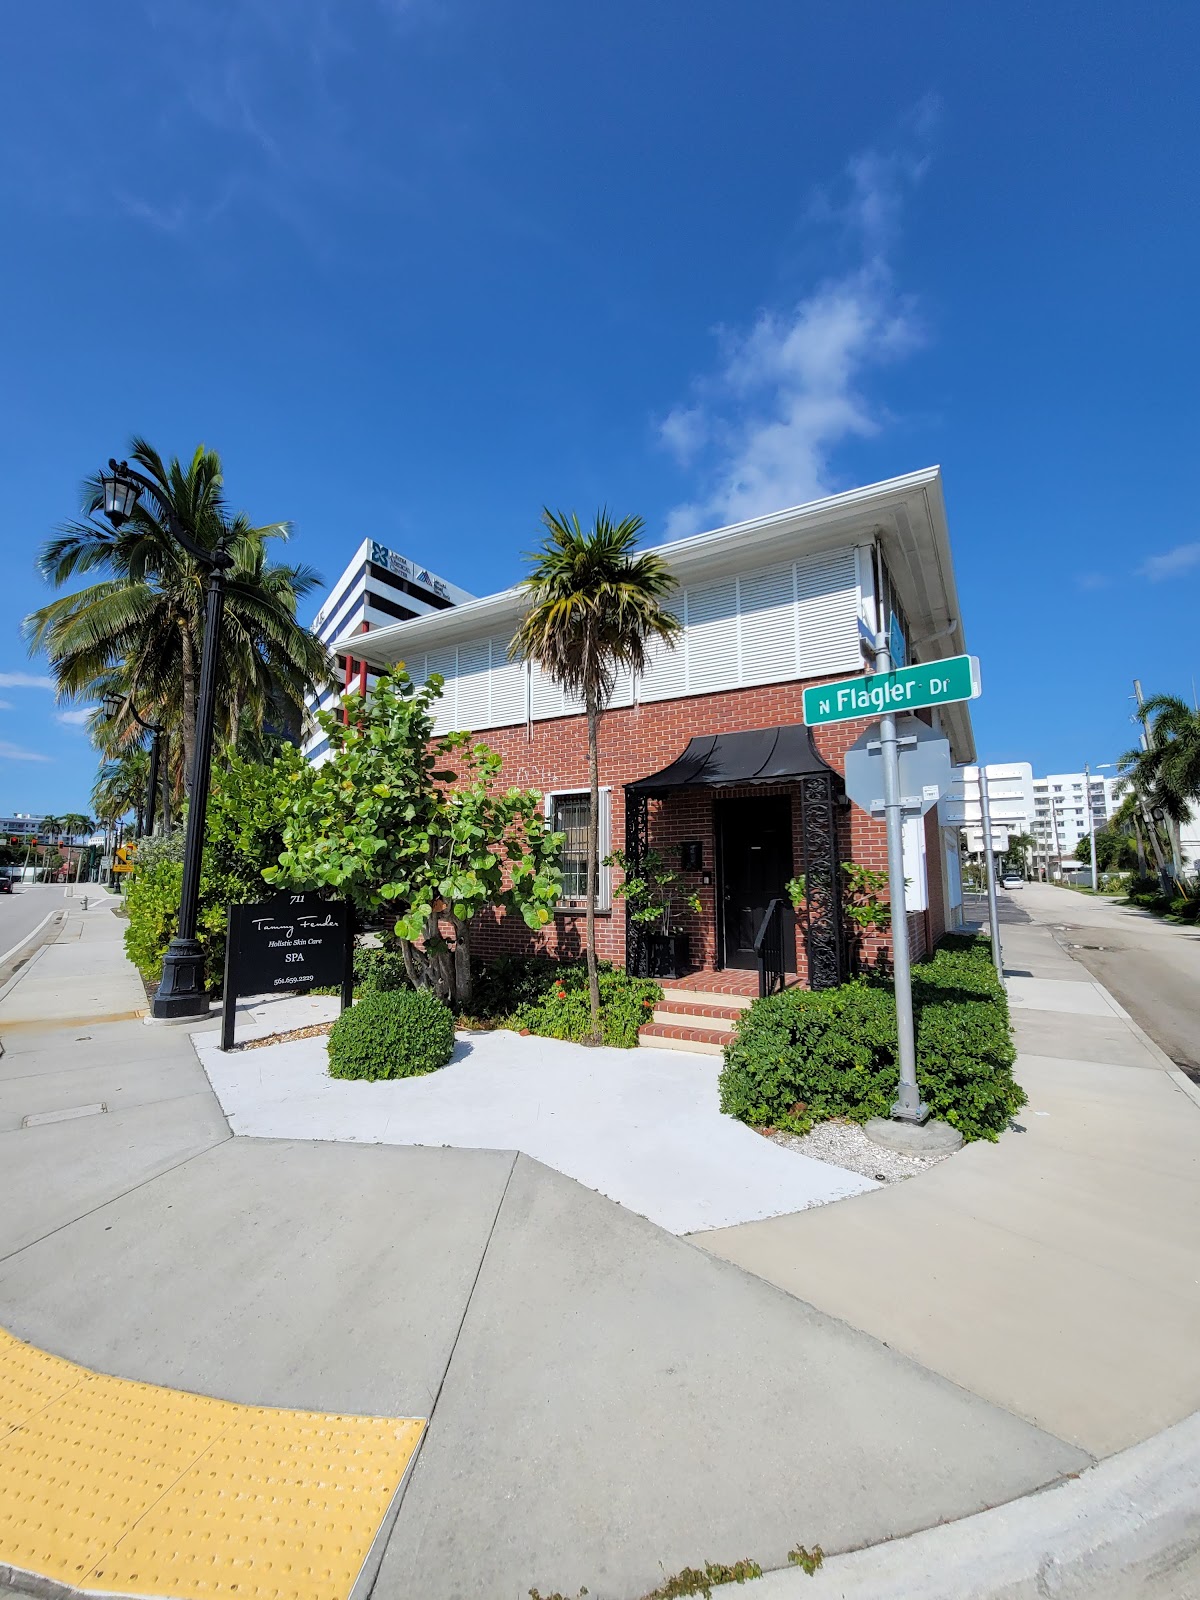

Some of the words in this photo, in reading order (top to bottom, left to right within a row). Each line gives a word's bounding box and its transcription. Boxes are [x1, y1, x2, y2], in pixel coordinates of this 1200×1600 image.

[819, 699, 830, 715] N
[837, 680, 916, 712] Flagler
[930, 678, 950, 695] Dr
[290, 895, 305, 905] 711
[252, 917, 294, 938] Tammy
[297, 914, 339, 928] Fender
[268, 940, 292, 948] Holistic
[285, 953, 304, 963] SPA
[273, 975, 314, 986] 561.659.2229
